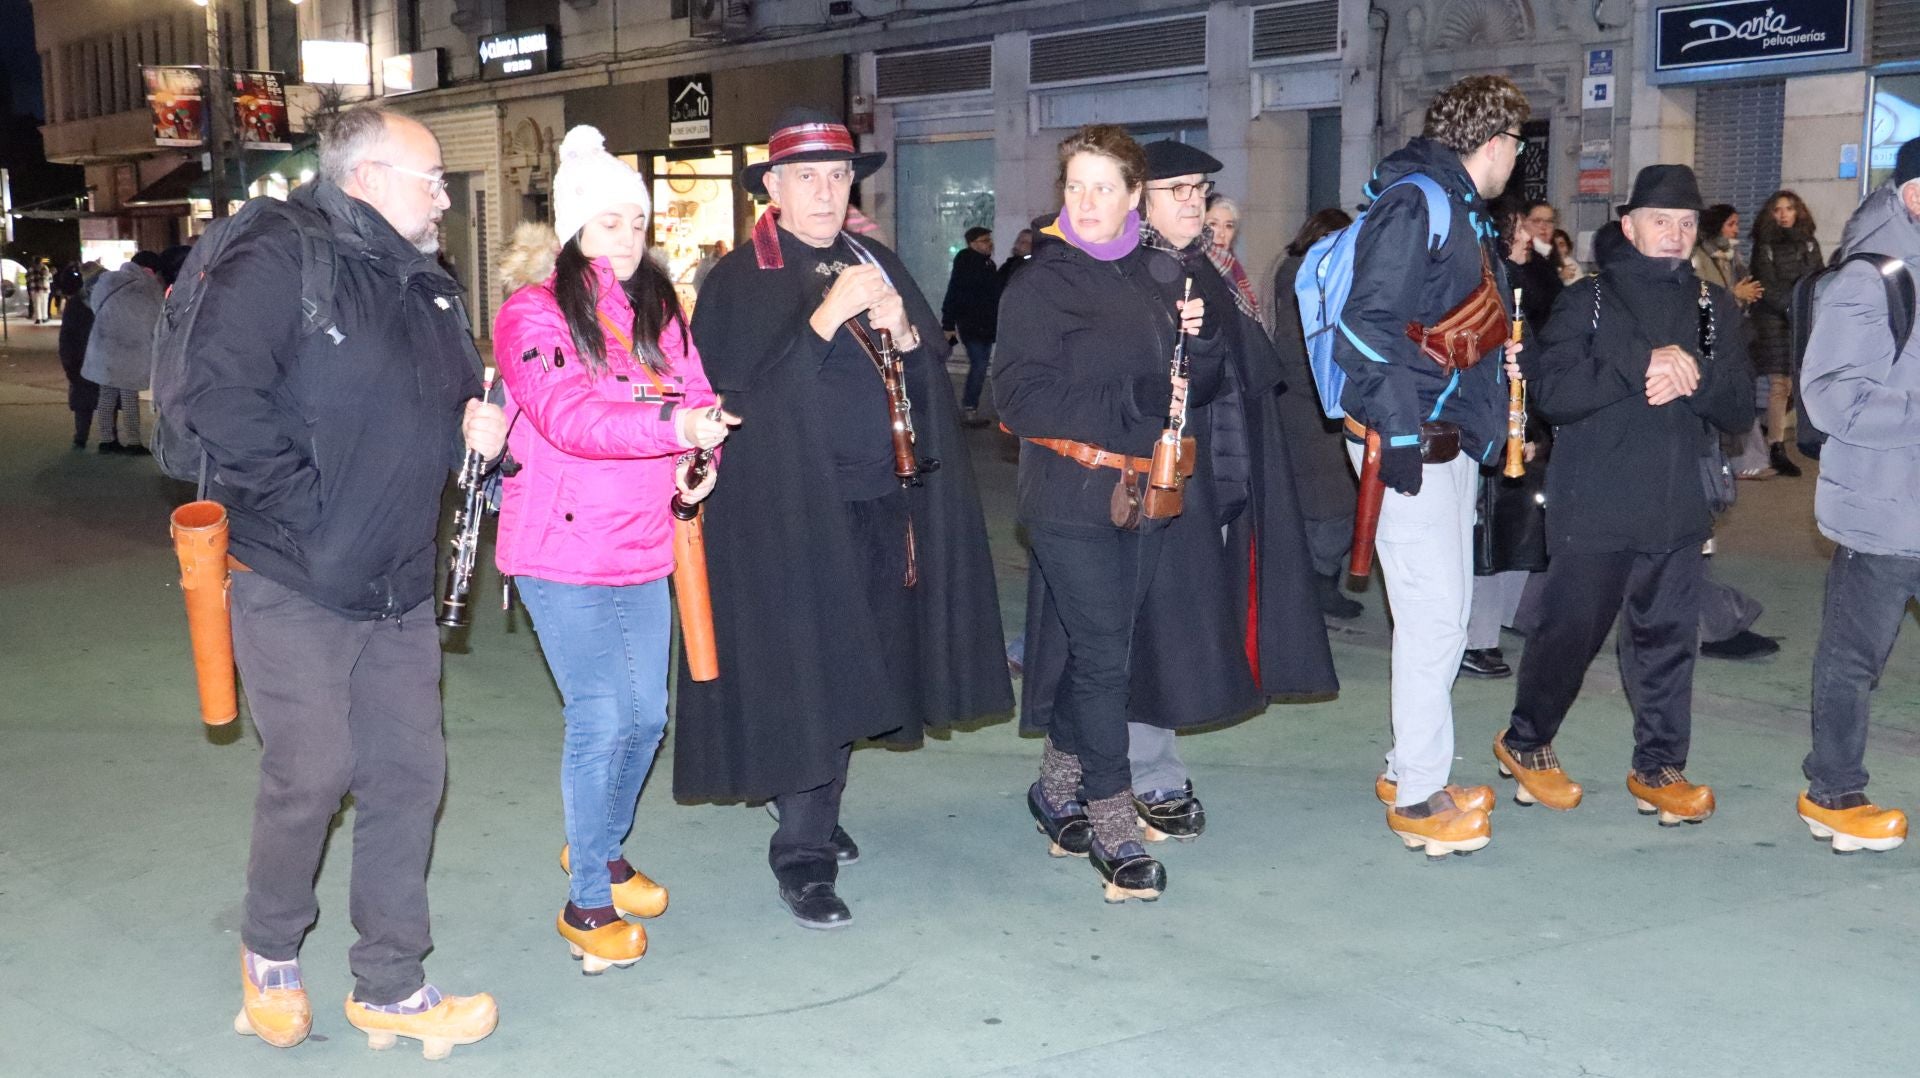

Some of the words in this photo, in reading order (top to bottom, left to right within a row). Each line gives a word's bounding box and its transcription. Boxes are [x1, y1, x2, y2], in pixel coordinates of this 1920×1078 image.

[1681, 7, 1801, 52] Dania
[1763, 29, 1826, 49] peluquerías
[697, 95, 709, 116] 10
